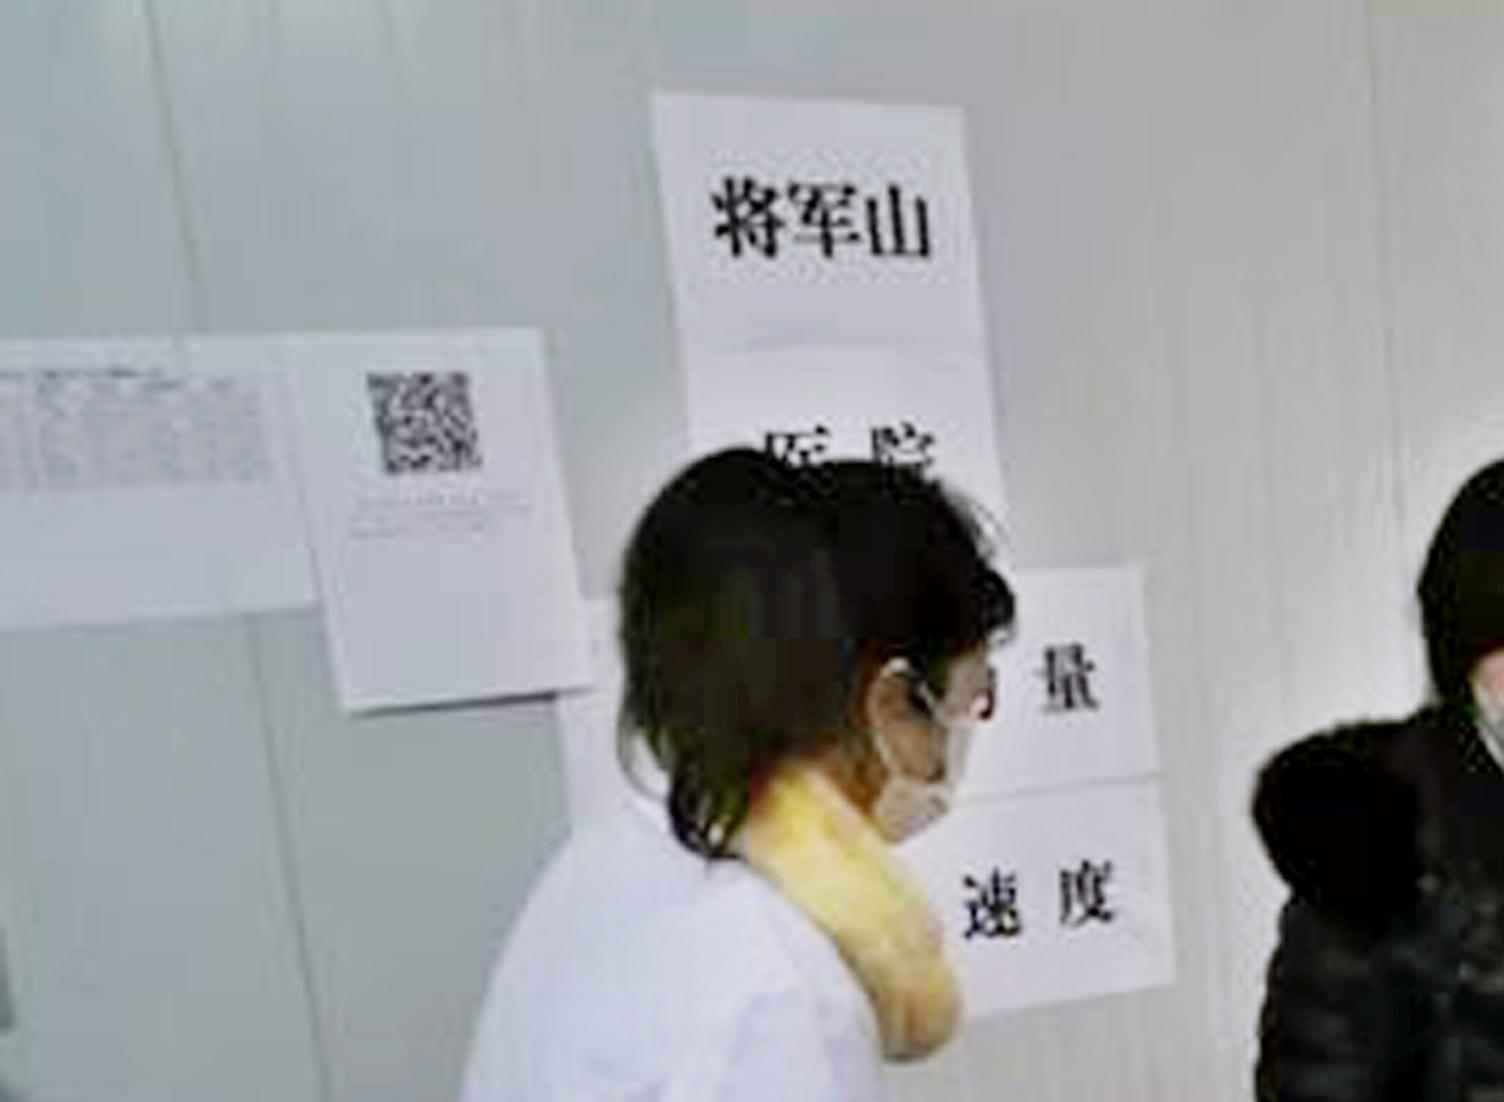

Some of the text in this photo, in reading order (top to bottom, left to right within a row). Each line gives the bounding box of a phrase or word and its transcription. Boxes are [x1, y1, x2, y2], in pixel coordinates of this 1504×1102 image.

[710, 174, 932, 260] 将军山
[1042, 642, 1098, 713] 量
[963, 858, 1115, 940] 速度
